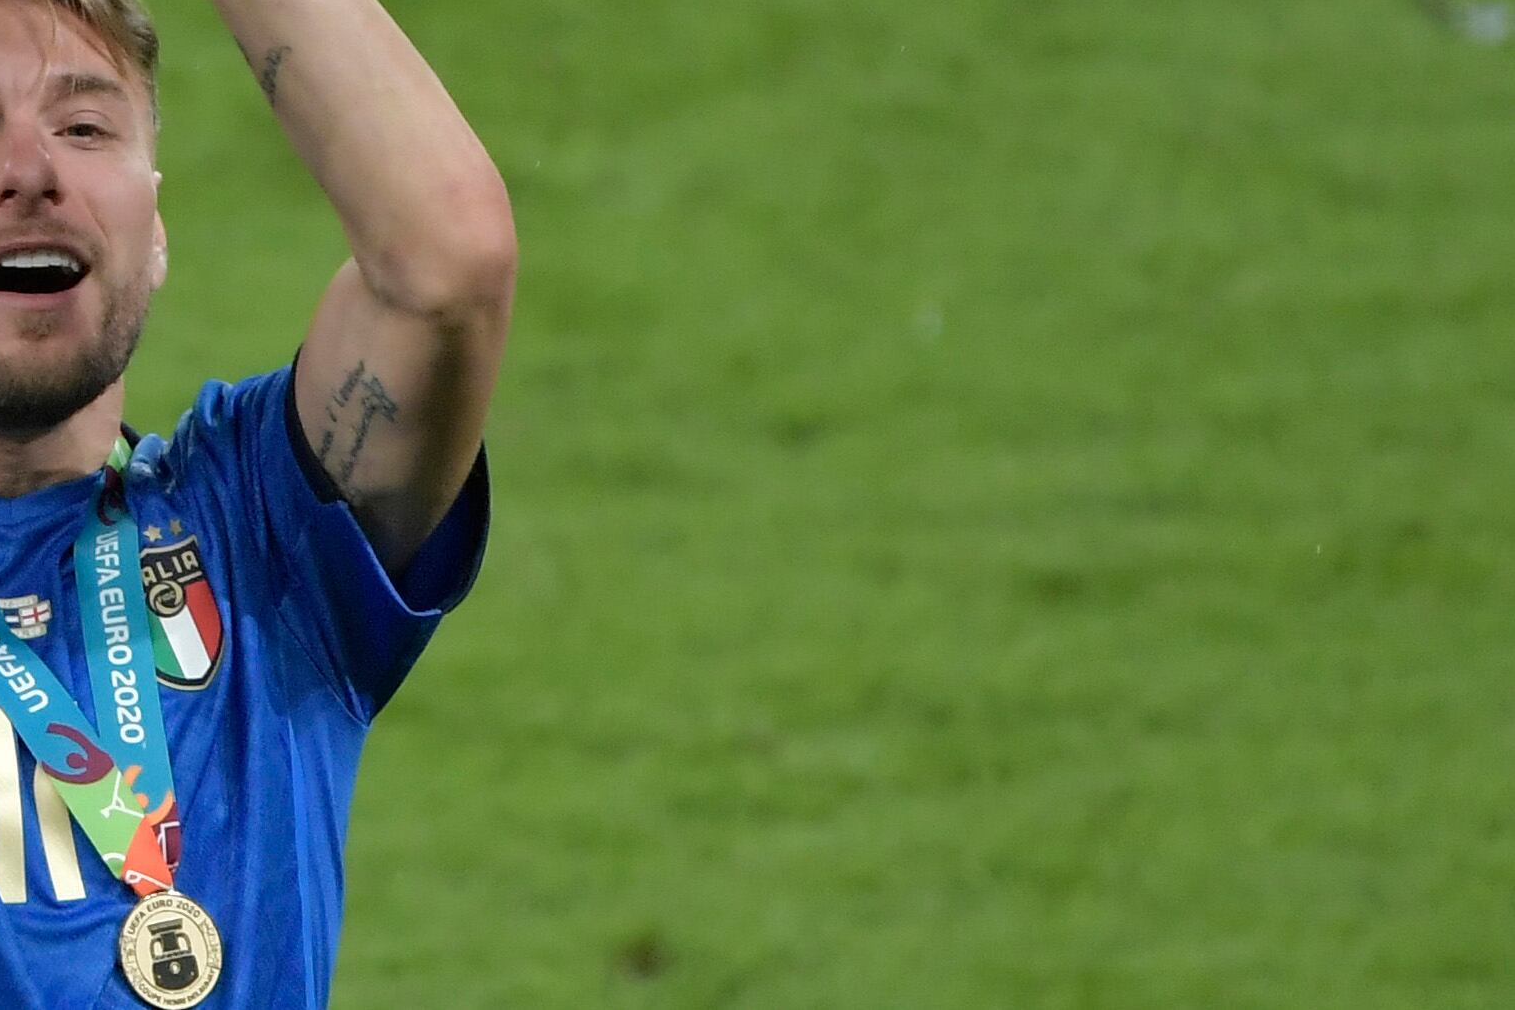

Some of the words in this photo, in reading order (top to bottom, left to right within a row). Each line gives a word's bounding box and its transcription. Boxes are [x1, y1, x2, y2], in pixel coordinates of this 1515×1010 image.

[95, 531, 121, 586] UEFA
[142, 550, 199, 587] ALIA
[99, 587, 132, 665] EURO
[111, 669, 145, 745] 2020
[127, 911, 146, 935] UEFA
[146, 898, 173, 912] EURO
[176, 900, 201, 918] 2020
